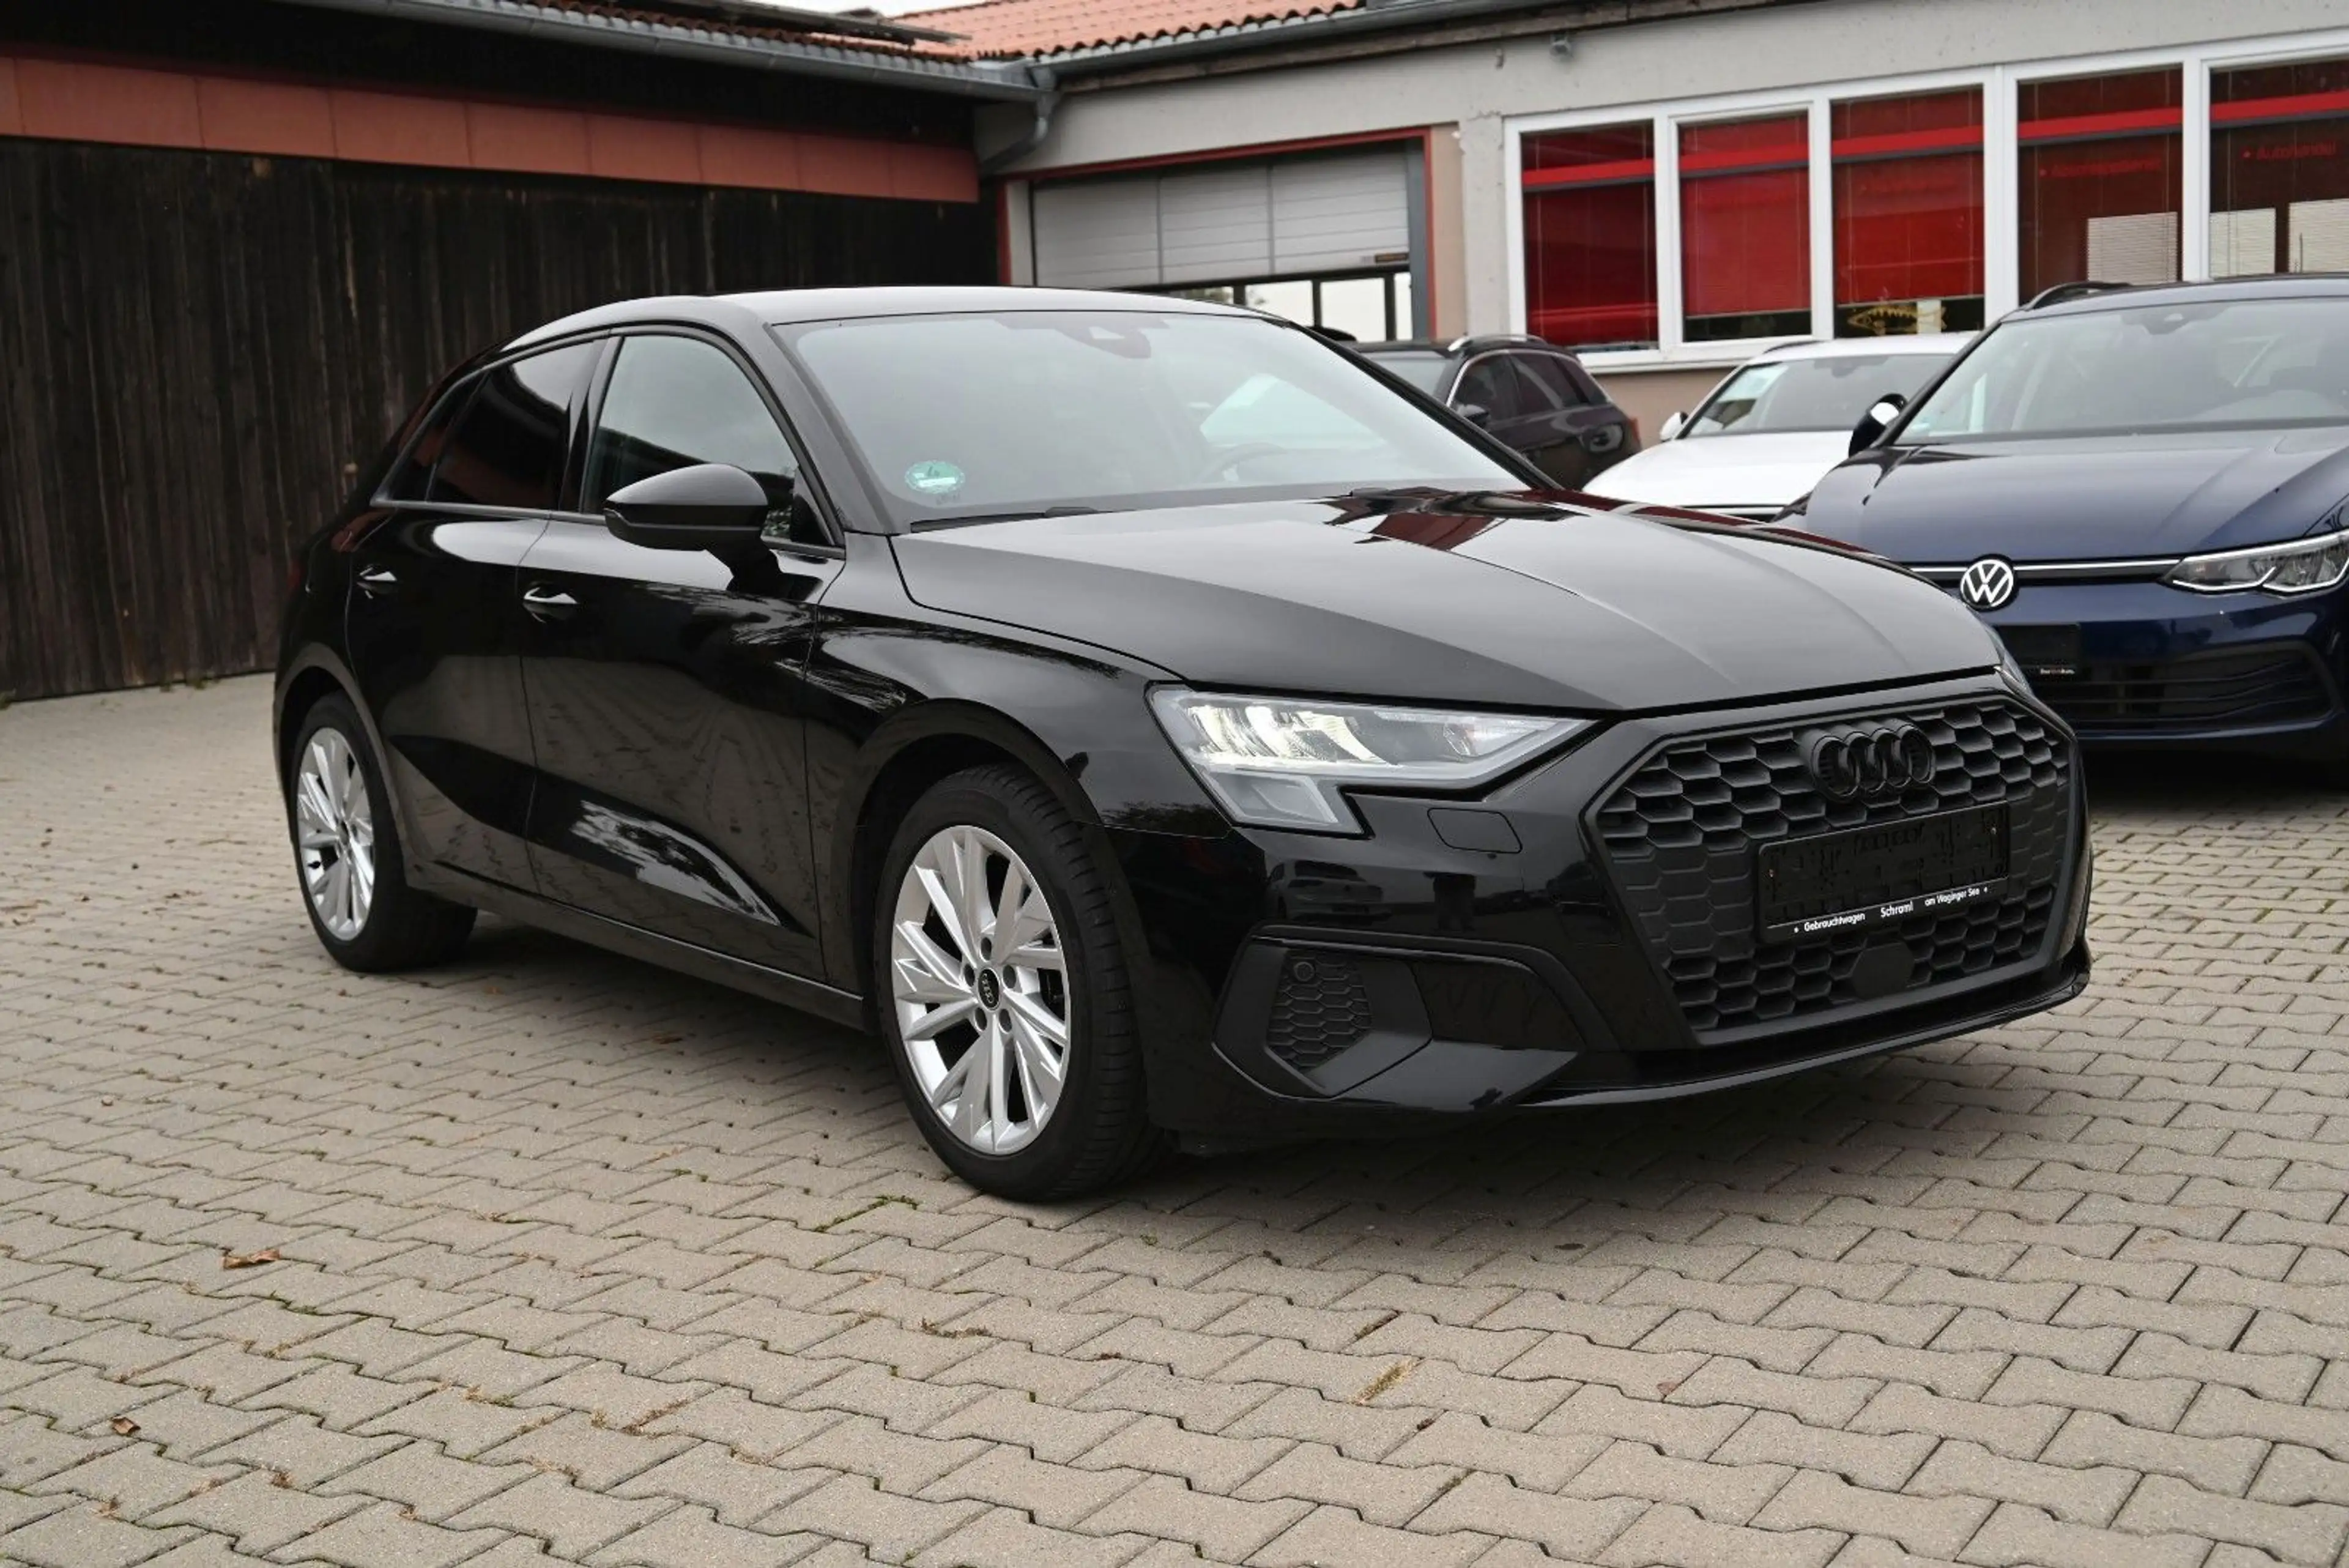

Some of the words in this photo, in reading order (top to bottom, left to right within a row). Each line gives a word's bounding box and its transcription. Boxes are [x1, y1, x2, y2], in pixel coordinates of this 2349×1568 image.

[1962, 561, 2012, 604] VW
[1804, 913, 1865, 932] Gebrauchtwagen
[1880, 901, 1914, 918] Schraml
[1924, 898, 1936, 907] am
[1967, 888, 1981, 897] See
